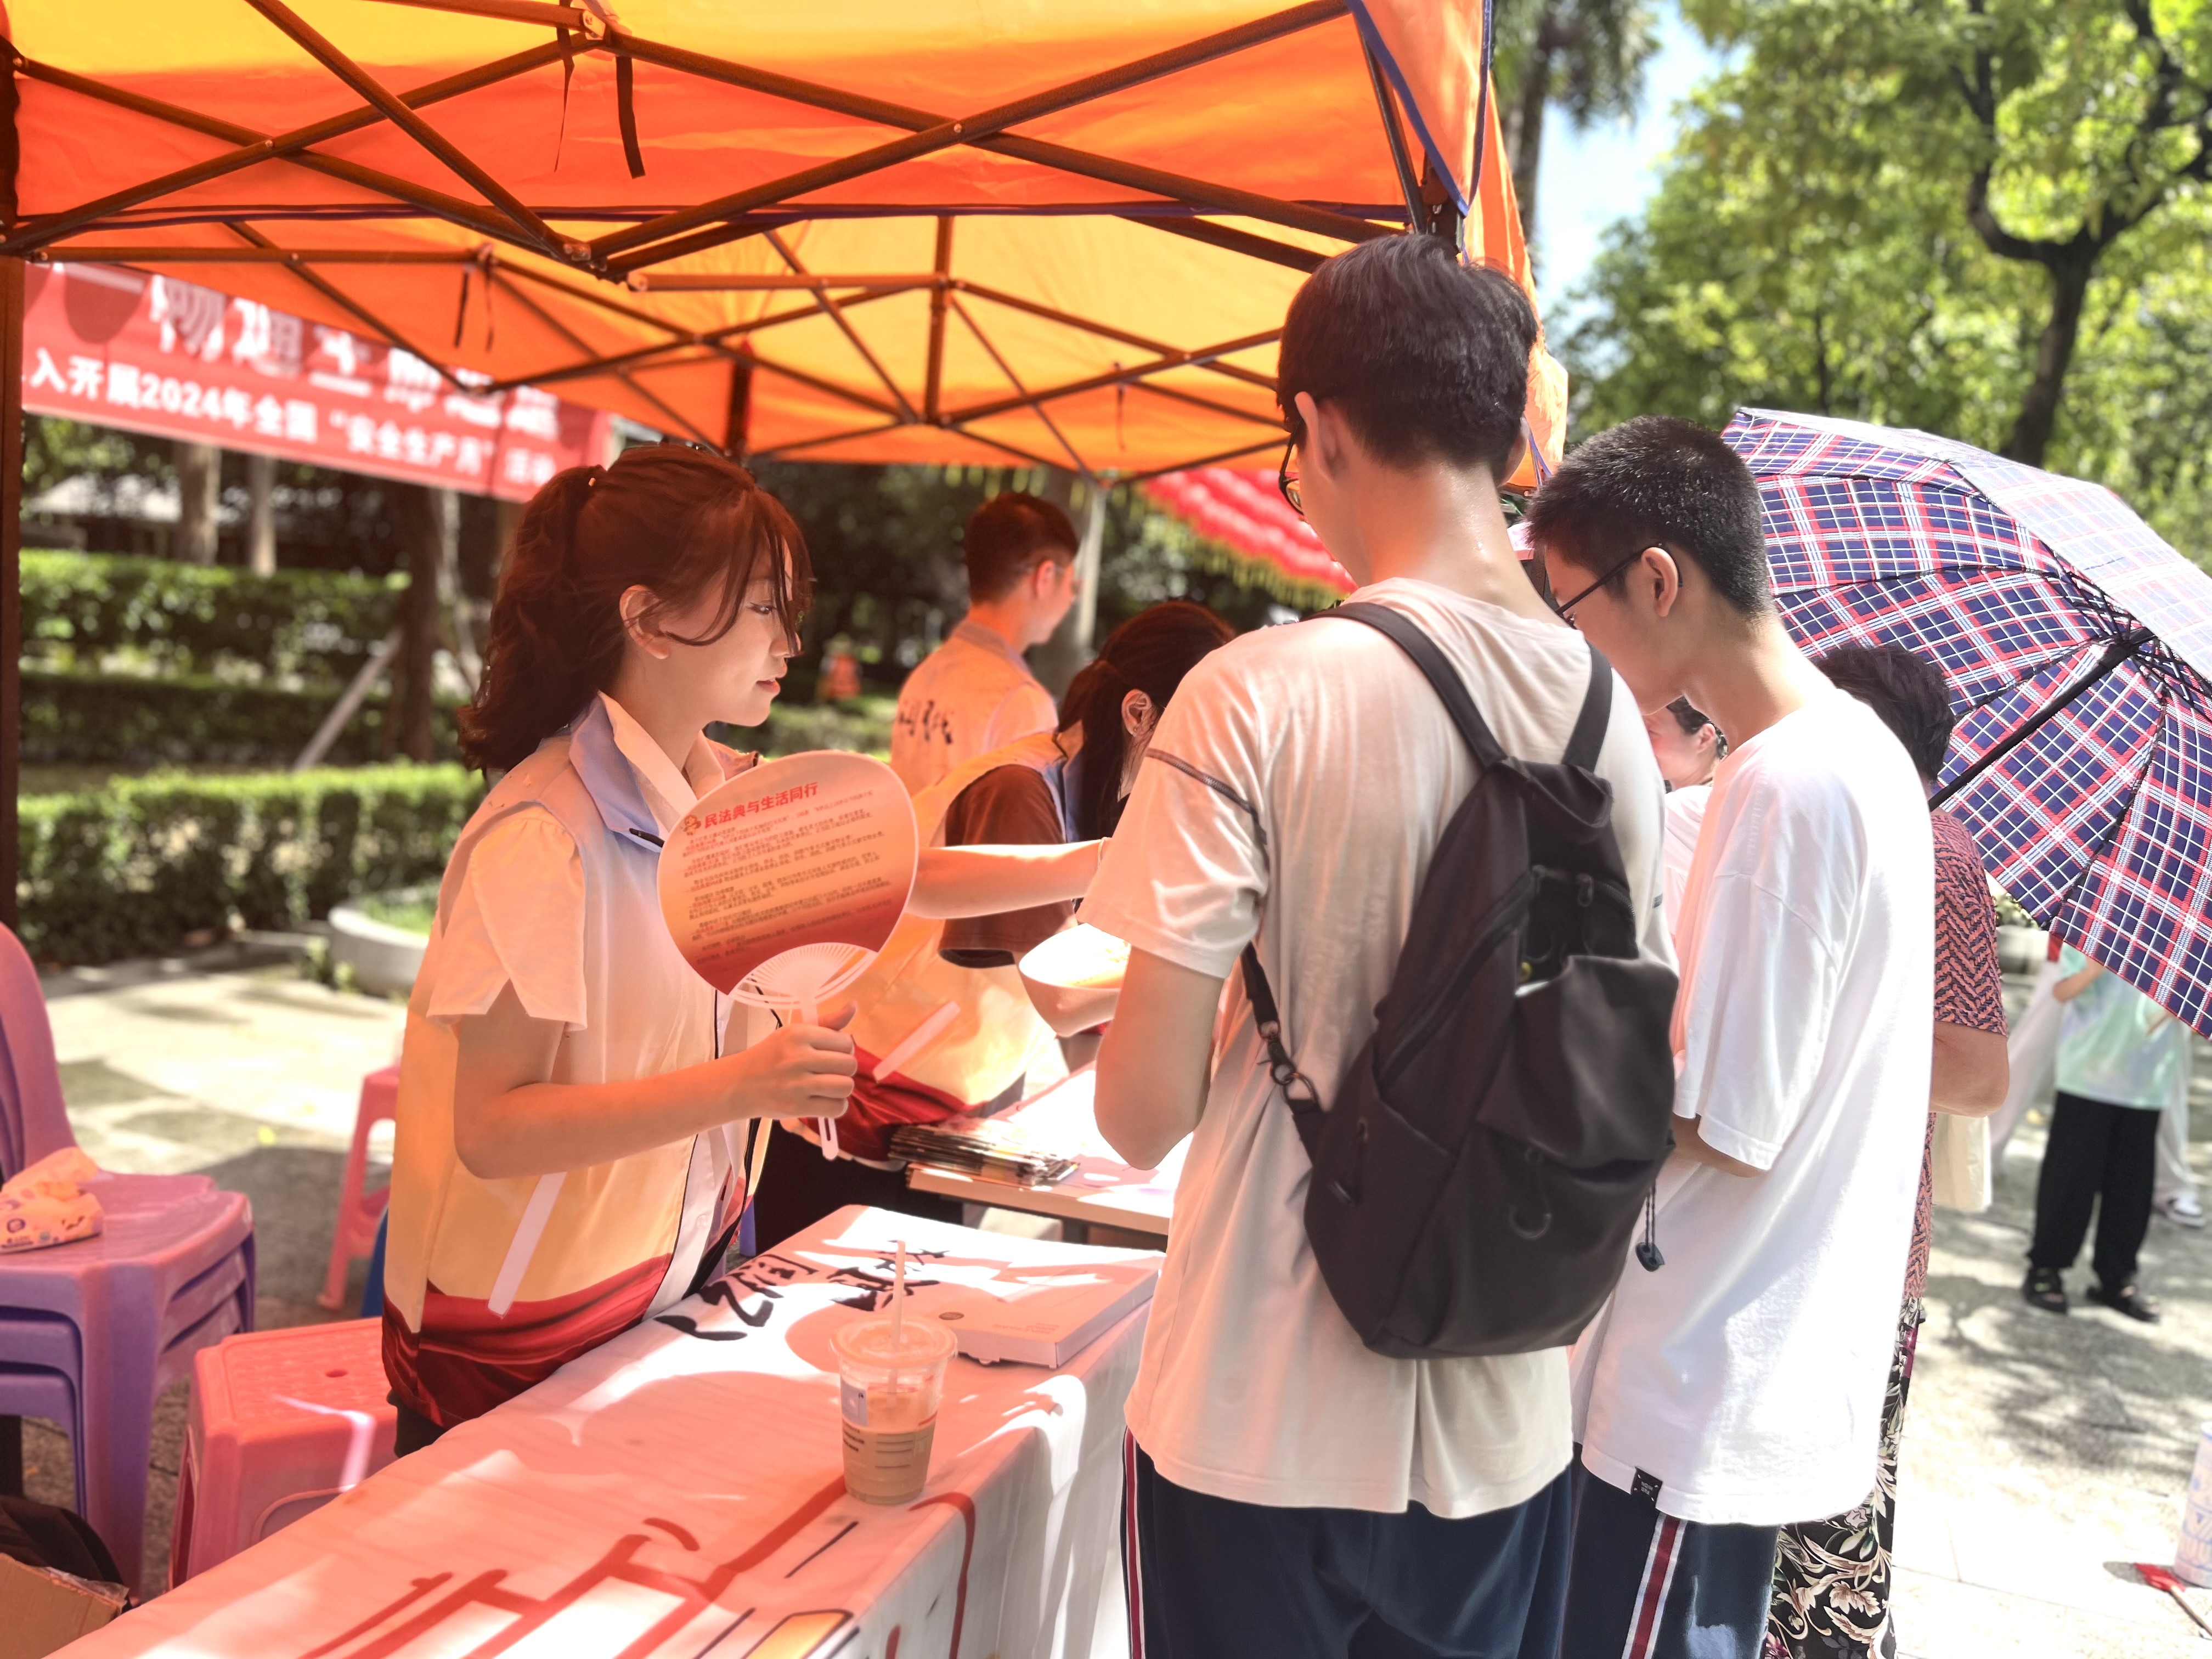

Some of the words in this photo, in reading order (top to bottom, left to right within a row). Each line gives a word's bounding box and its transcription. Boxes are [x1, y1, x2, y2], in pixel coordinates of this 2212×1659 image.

[705, 782, 819, 827] 民法典与生活同行
